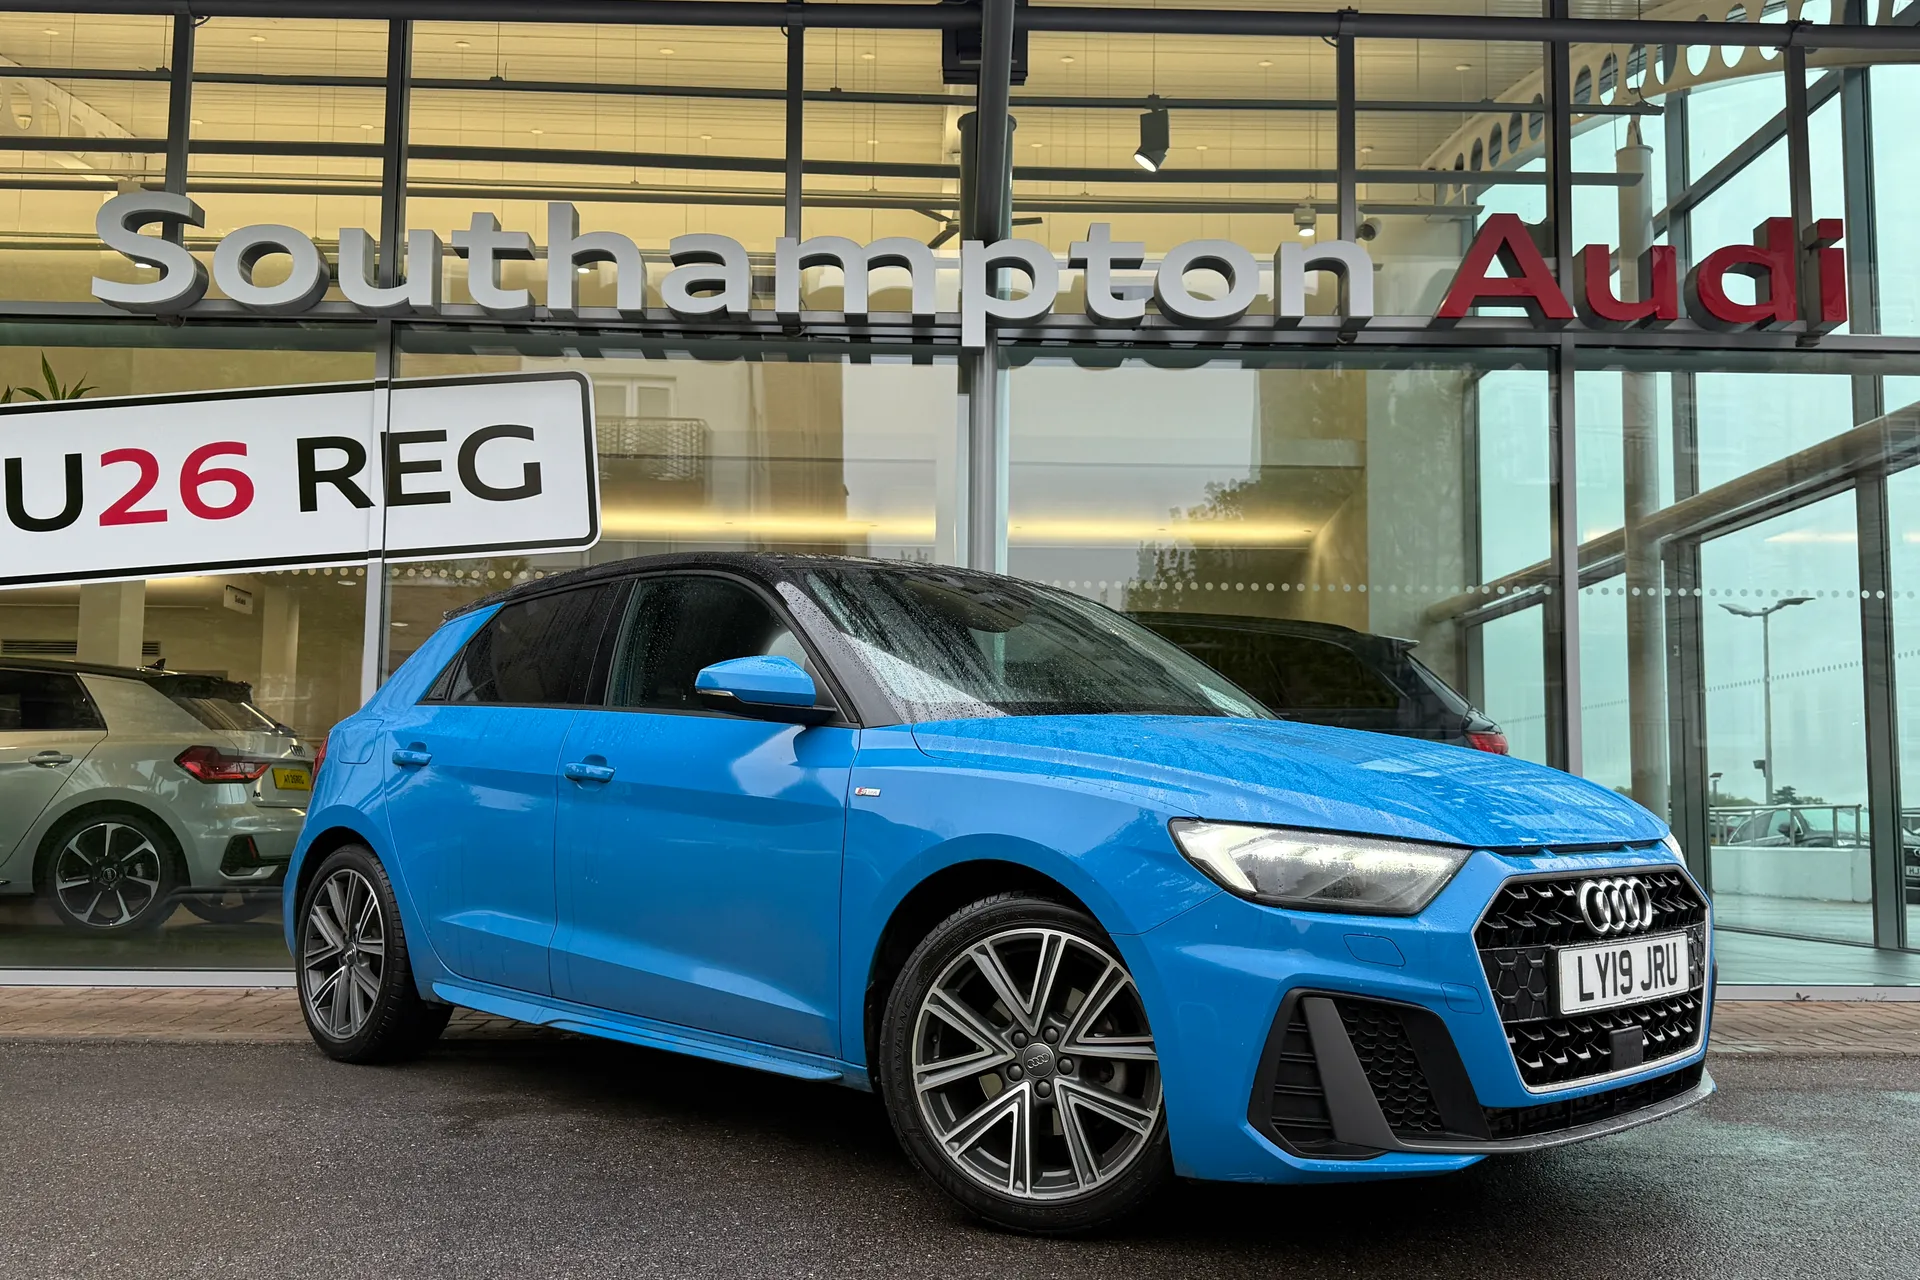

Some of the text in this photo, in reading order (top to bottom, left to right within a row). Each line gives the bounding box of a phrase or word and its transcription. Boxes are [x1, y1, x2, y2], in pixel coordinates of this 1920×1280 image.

[92, 190, 1848, 348] Southampton Audi
[4, 424, 542, 532] U26 REG
[1577, 942, 1678, 1002] LY19 JRU
